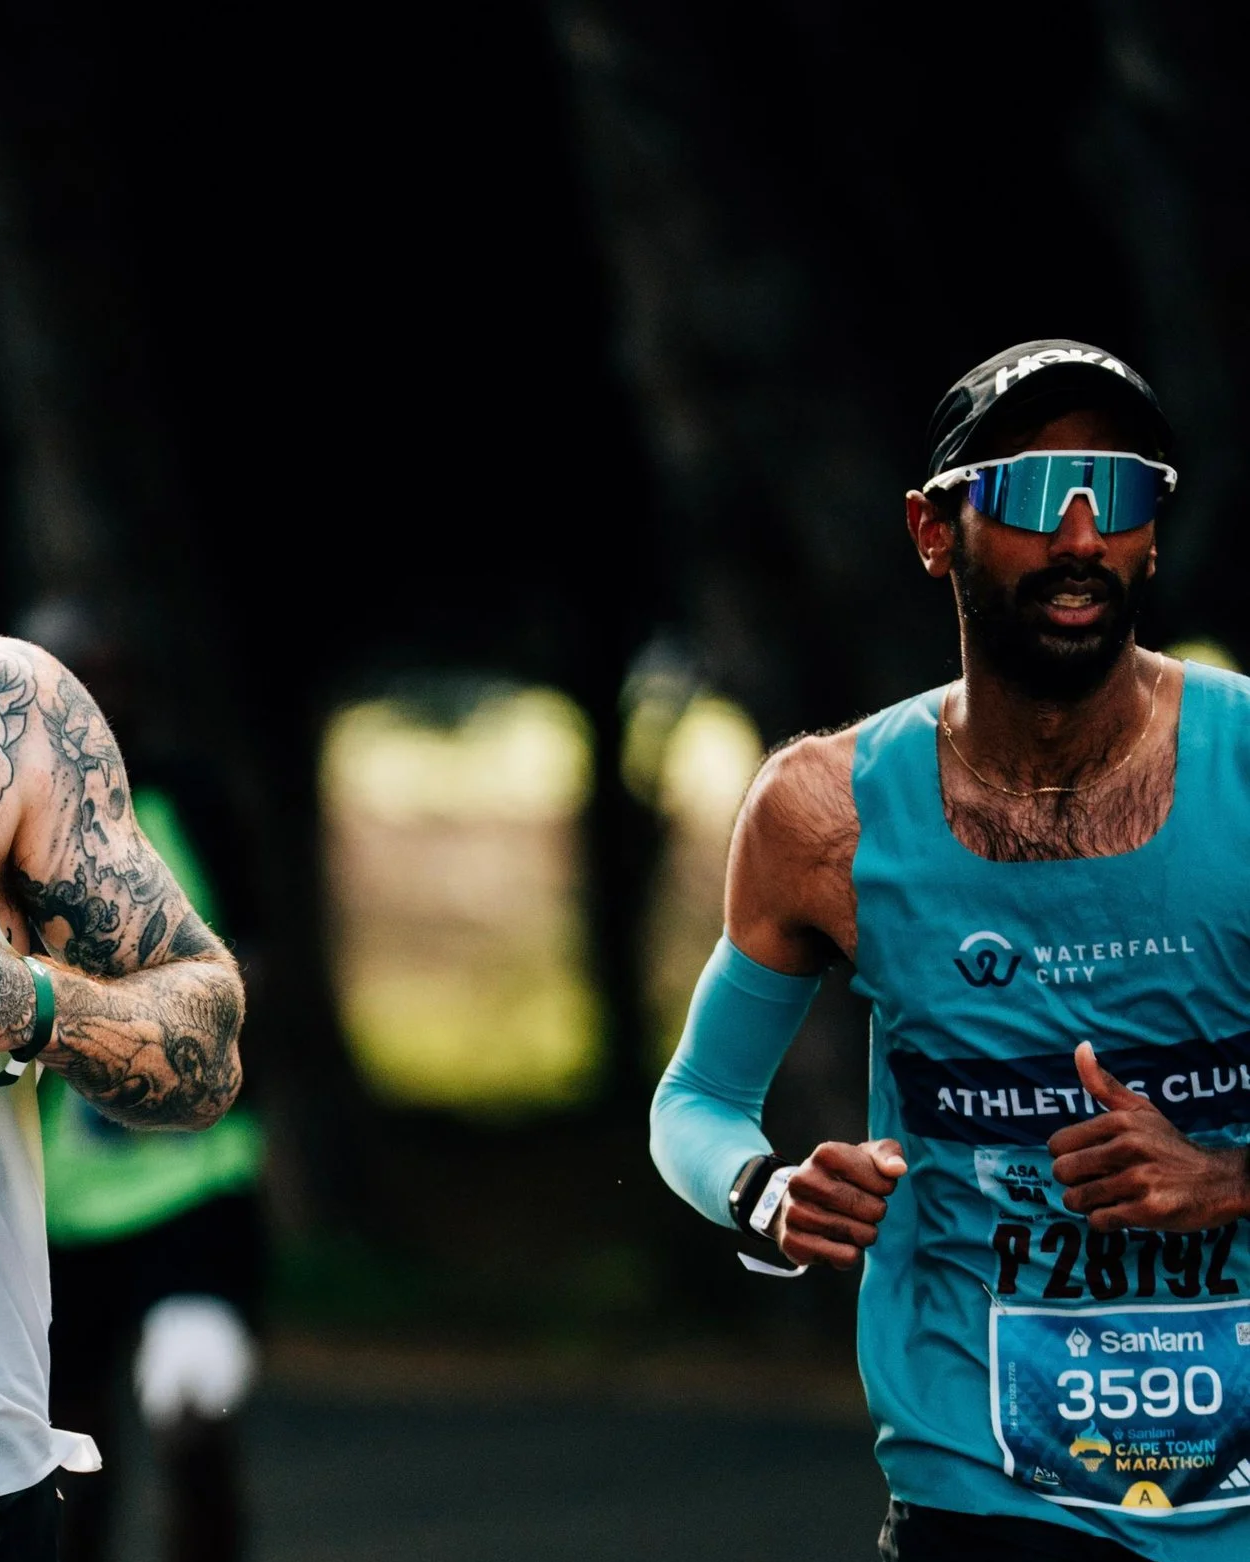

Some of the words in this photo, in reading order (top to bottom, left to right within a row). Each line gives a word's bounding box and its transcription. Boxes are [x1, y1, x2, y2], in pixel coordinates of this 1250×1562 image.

[1033, 935, 1195, 963] WATERFALL
[1036, 966, 1096, 985] CITY
[937, 1080, 1151, 1117] ATHLETIS
[1005, 1164, 1040, 1178] ASA
[1100, 1326, 1205, 1354] Sanlam
[1057, 1365, 1223, 1421] 3590
[1127, 1427, 1176, 1440] Sanlam
[1115, 1442, 1161, 1457] CAPE
[1166, 1439, 1217, 1454] TOWN
[1115, 1455, 1216, 1472] MARATHON
[1139, 1489, 1153, 1505] A
